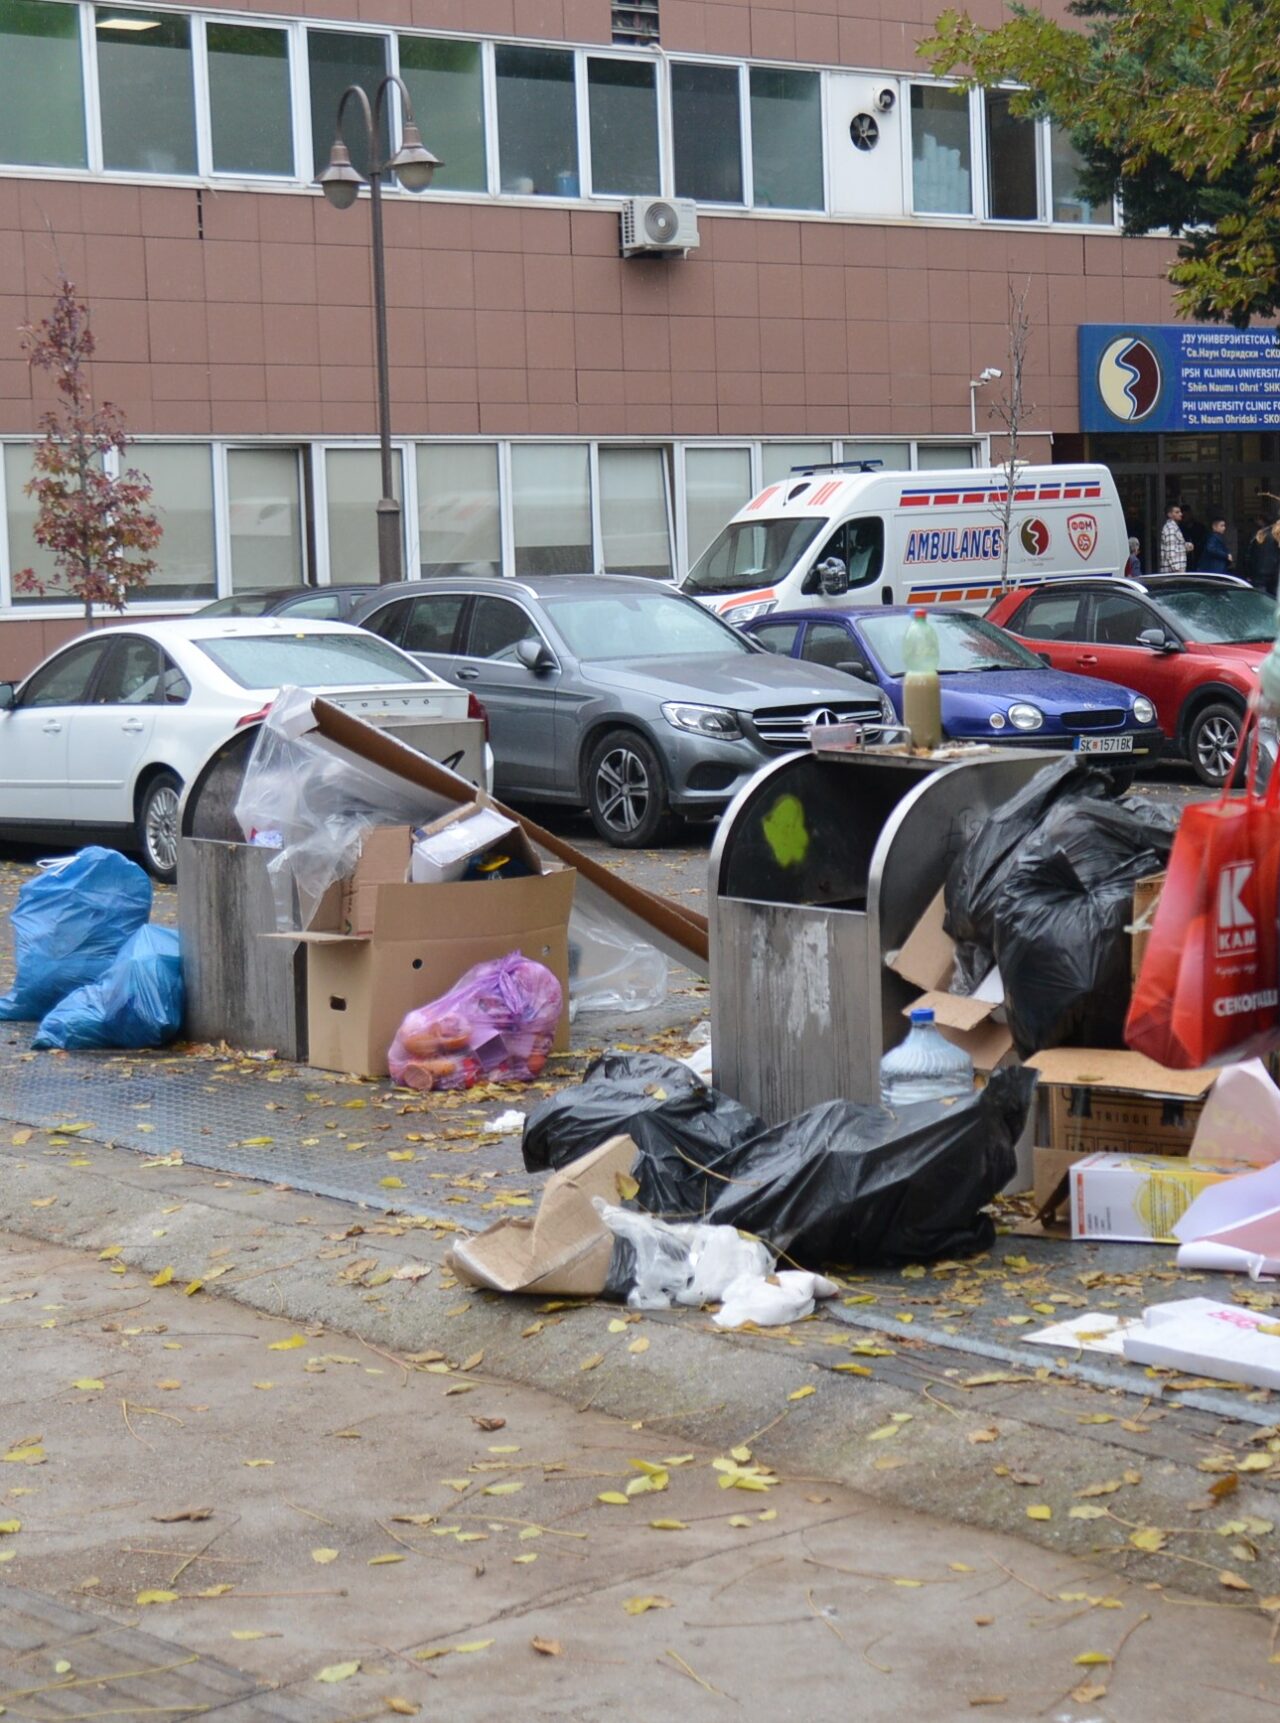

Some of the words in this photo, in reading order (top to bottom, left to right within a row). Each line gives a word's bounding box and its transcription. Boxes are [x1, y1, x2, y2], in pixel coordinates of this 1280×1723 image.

[1197, 334, 1270, 345] УНИВЕРЗИТЕТСКА
[1181, 368, 1200, 378] IPSH
[1203, 368, 1236, 378] KLINIKA
[1182, 401, 1197, 411] PHI
[1197, 401, 1244, 411] UNIVERSITY
[1245, 401, 1272, 411] CLINIC
[1201, 414, 1224, 424] Naum
[1225, 414, 1257, 424] Ohridski
[904, 526, 1003, 564] AMBULANCE
[1080, 739, 1092, 752] SK
